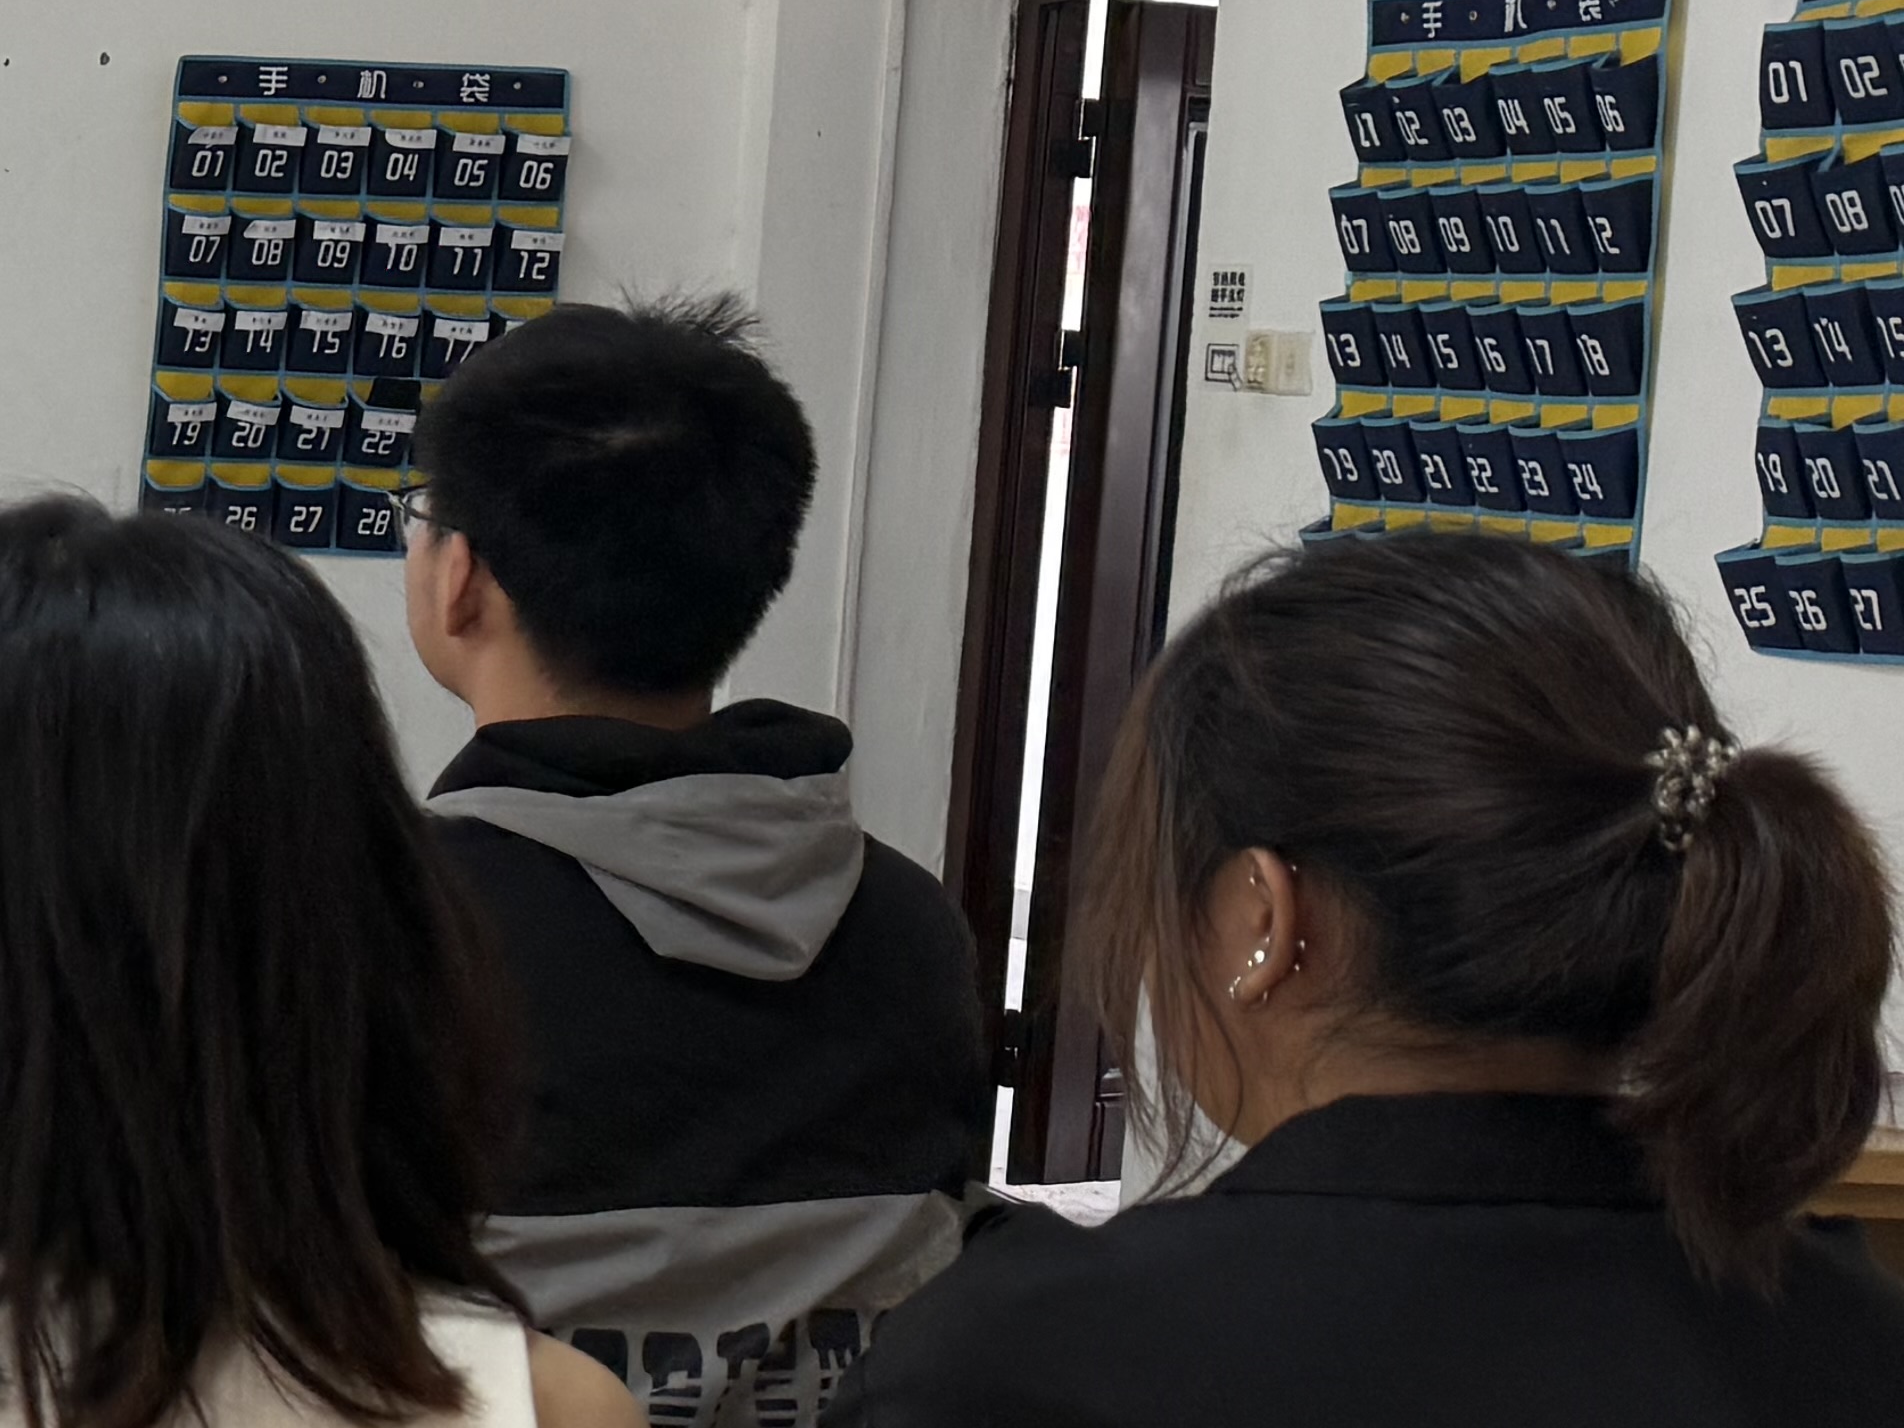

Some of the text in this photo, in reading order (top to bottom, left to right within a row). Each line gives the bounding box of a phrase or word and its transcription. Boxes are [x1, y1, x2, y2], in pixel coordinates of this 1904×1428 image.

[258, 63, 494, 103] 手机袋
[1768, 60, 1808, 104] 01
[1839, 55, 1888, 99] 02
[1395, 110, 1429, 146] 02
[1442, 107, 1477, 143] 03
[1497, 98, 1530, 135] 04
[1543, 96, 1576, 134] 05
[1595, 94, 1625, 133] 06
[191, 149, 554, 190] 01 02 03 04 05 06
[1340, 215, 1621, 256] 07 08 09 10 11 12
[1753, 198, 1796, 241] 07
[1825, 189, 1869, 233] 08
[188, 235, 550, 280] 07 08 09 10 11 12
[183, 329, 213, 352] 13
[246, 329, 274, 353] 14
[312, 329, 342, 354] 15
[379, 335, 407, 359] 16
[1326, 333, 1610, 376] 13 14 15 16 17 18
[1747, 328, 1794, 370] 13
[1813, 319, 1853, 363] 14
[172, 421, 396, 455] 19 20 21 22
[1322, 447, 1604, 500] 19 20 21 22 23 24
[1756, 452, 1901, 501] 19 20 21
[225, 505, 391, 536] 26 27 28
[1732, 585, 1883, 631] 25 26 27
